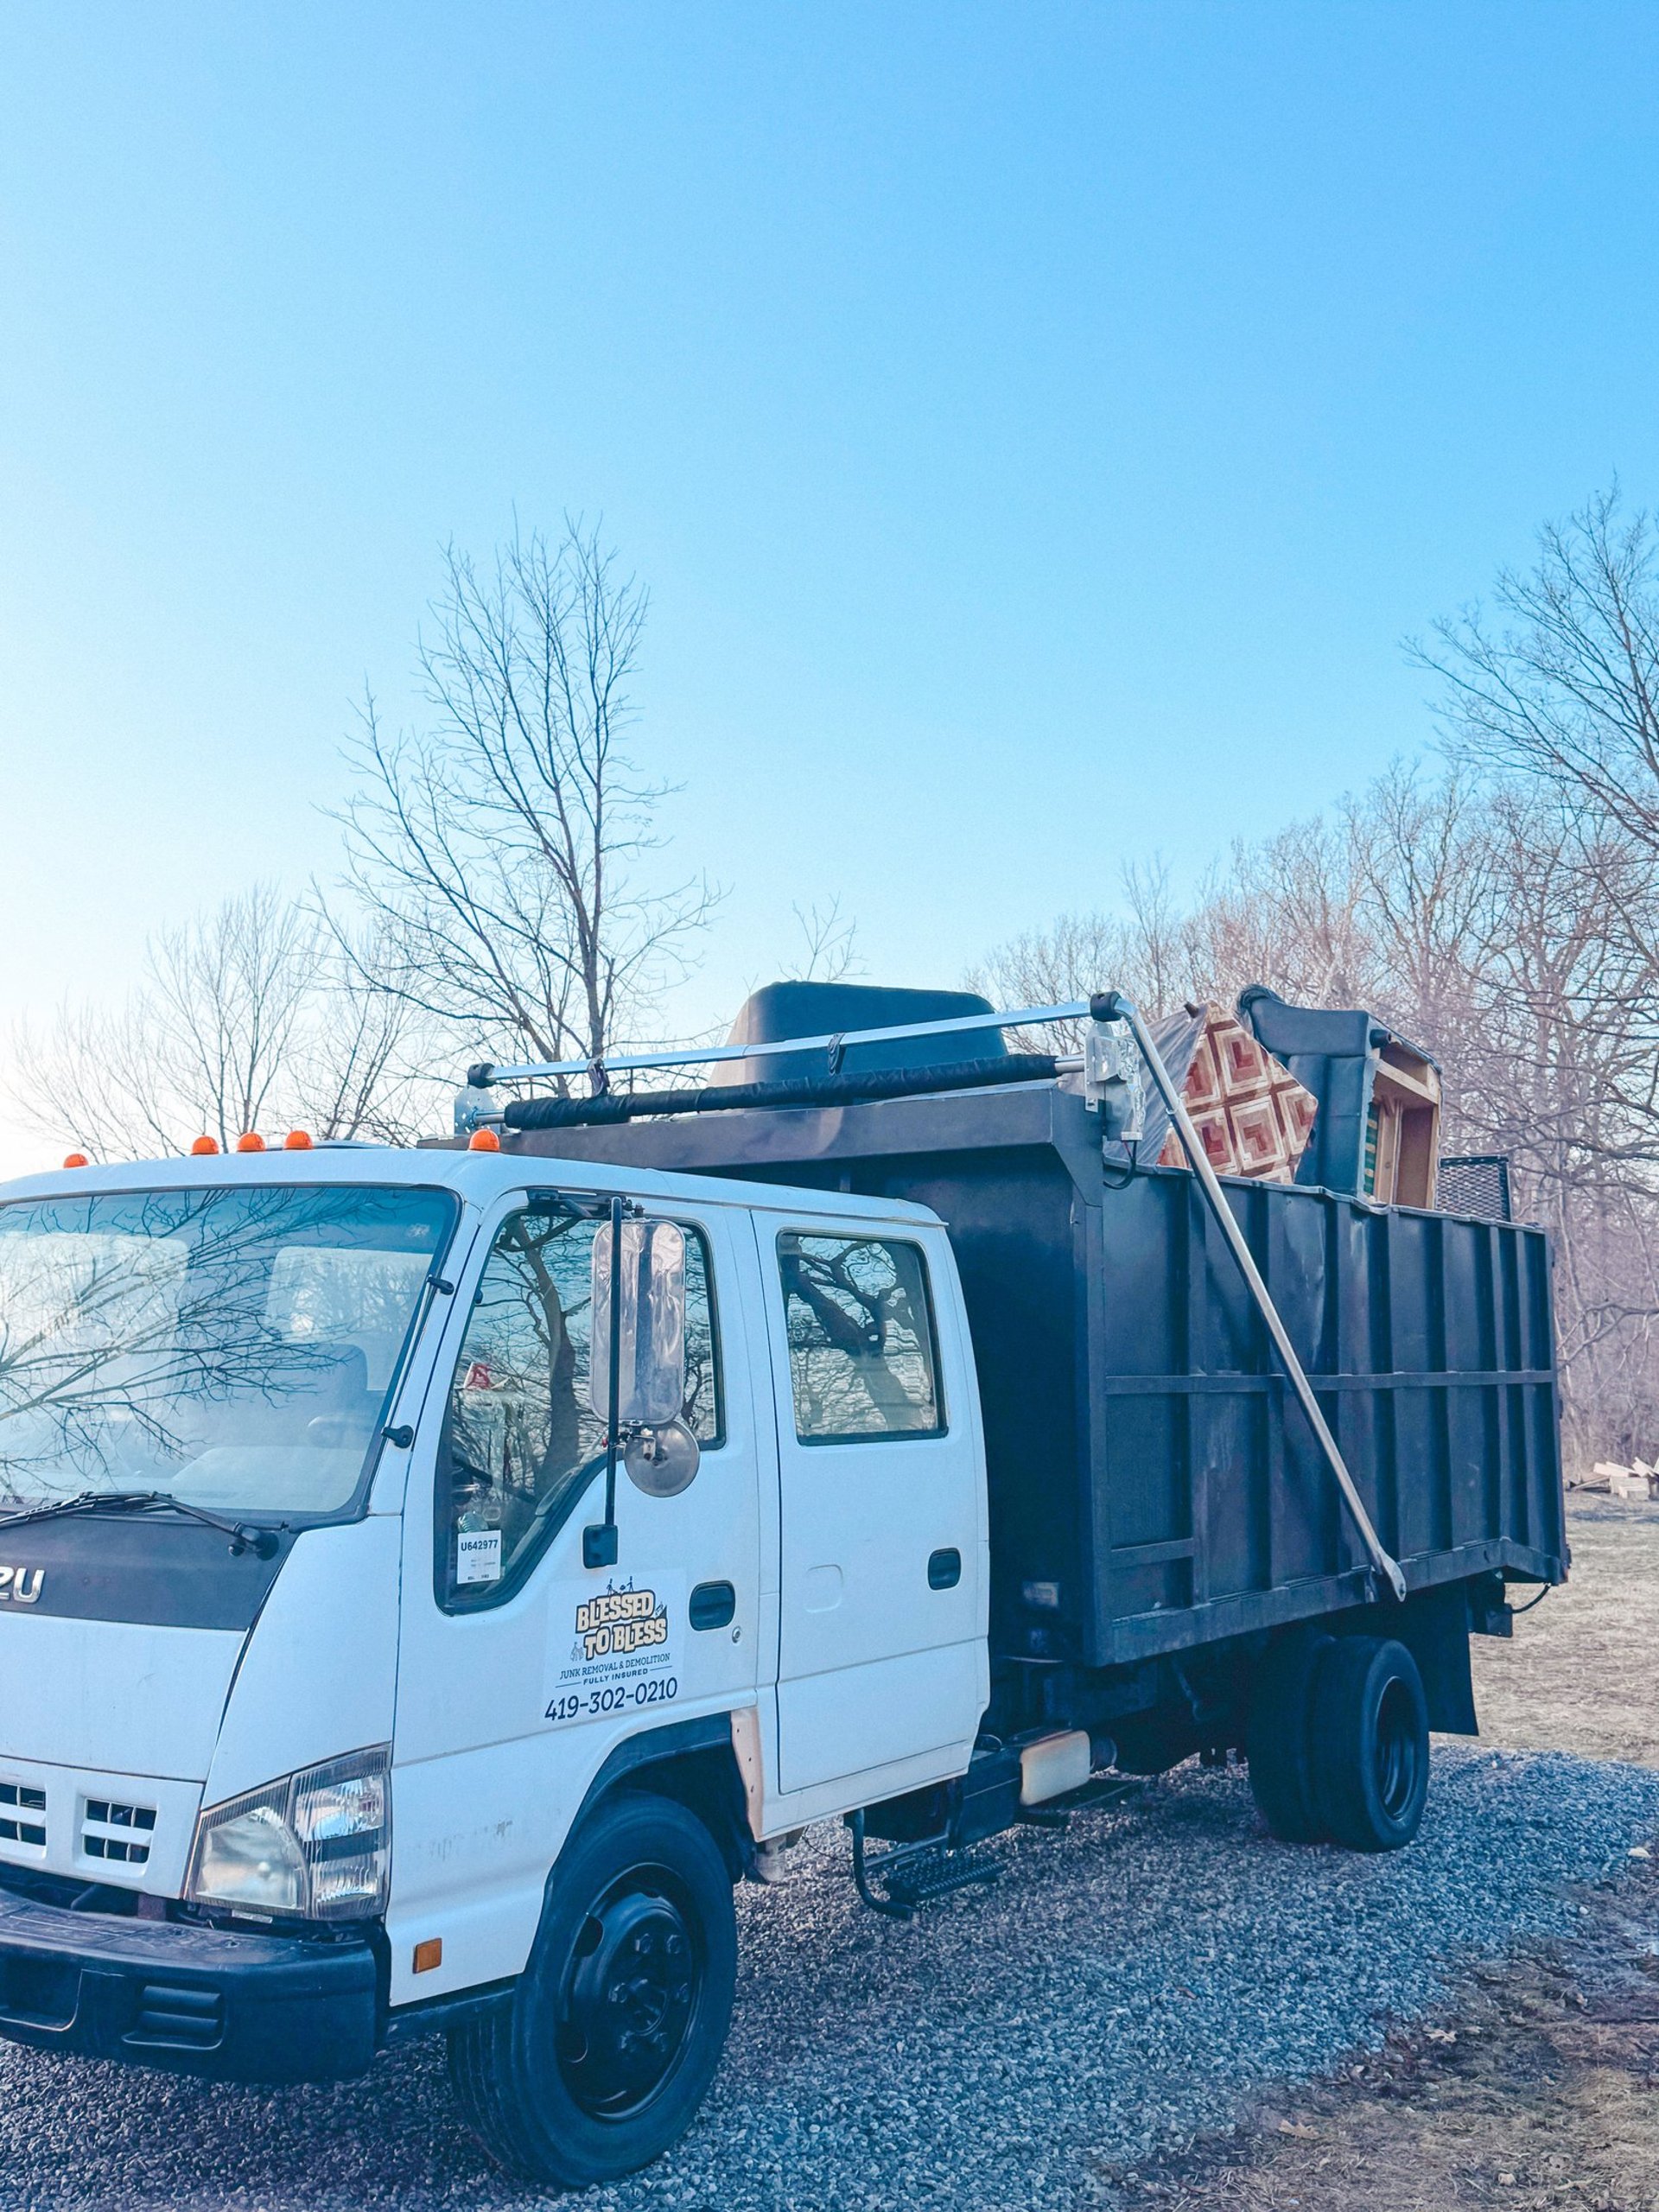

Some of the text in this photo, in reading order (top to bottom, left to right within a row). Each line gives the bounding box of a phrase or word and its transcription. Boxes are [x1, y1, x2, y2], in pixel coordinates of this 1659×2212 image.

[461, 1539, 499, 1552] U642977
[575, 1589, 655, 1633] BLESSED
[584, 1617, 668, 1661] TO BLESS
[560, 1652, 671, 1680] JUNK REMOVAL & DEMOLITION
[583, 1668, 648, 1685] FULLY INSURED
[544, 1677, 677, 1721] 419-302-0210
